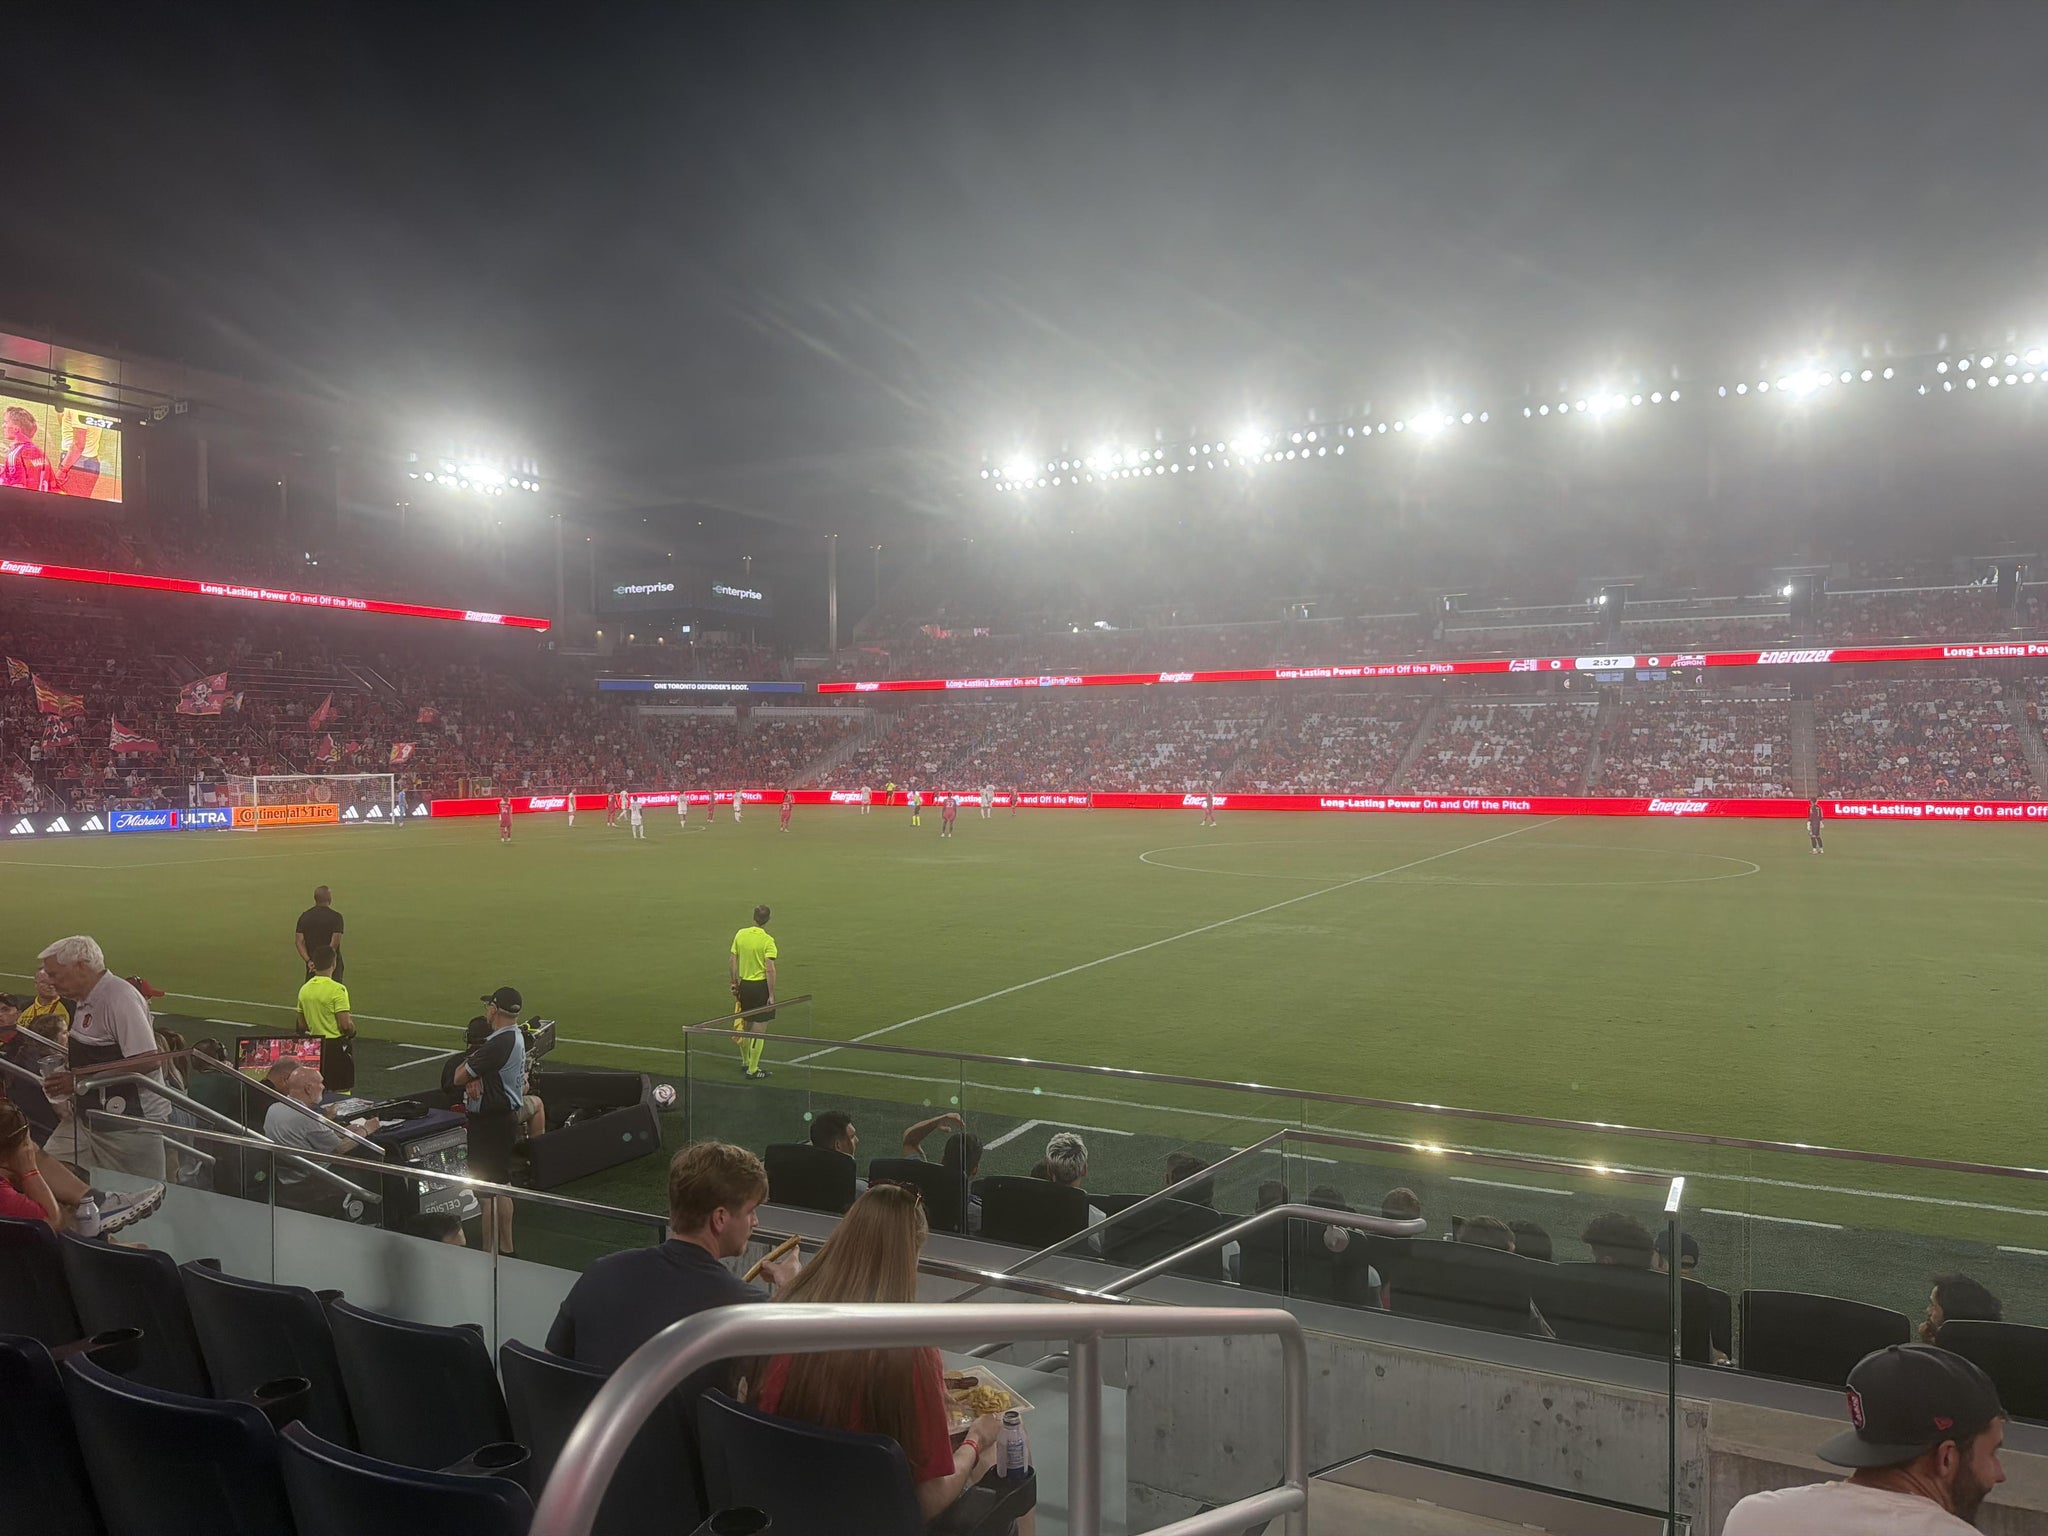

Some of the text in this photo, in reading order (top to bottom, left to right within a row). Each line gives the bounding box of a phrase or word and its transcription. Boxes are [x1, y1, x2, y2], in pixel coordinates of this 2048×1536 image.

[85, 416, 114, 429] 2:37
[0, 560, 43, 575] Energizer
[614, 581, 675, 596] enterprise
[712, 583, 763, 601] enterprise
[200, 584, 367, 610] Long-Lasting Power On and Off the Pitch
[1757, 649, 1834, 665] Energizer
[1943, 645, 2026, 657] Long-Lasting
[1592, 658, 1620, 667] 2:37
[1275, 663, 1454, 678] Long-Lasting Power On and Off the Pitch
[529, 796, 565, 810] Energizer
[1023, 796, 1038, 804] and
[1039, 796, 1052, 804] Off
[1053, 796, 1067, 804] the
[1320, 798, 1531, 811] Long-Lasting Power On and Off the Pitch
[1648, 799, 1708, 815] Energizer
[307, 806, 333, 818] Tire
[1834, 803, 1922, 817] Long-Lasting
[1925, 804, 1970, 817] Power
[1973, 805, 1993, 816] On
[1996, 805, 2023, 816] and
[116, 813, 167, 828] Michelob
[181, 811, 228, 824] ULTRA
[425, 1198, 461, 1214] CELSIUS
